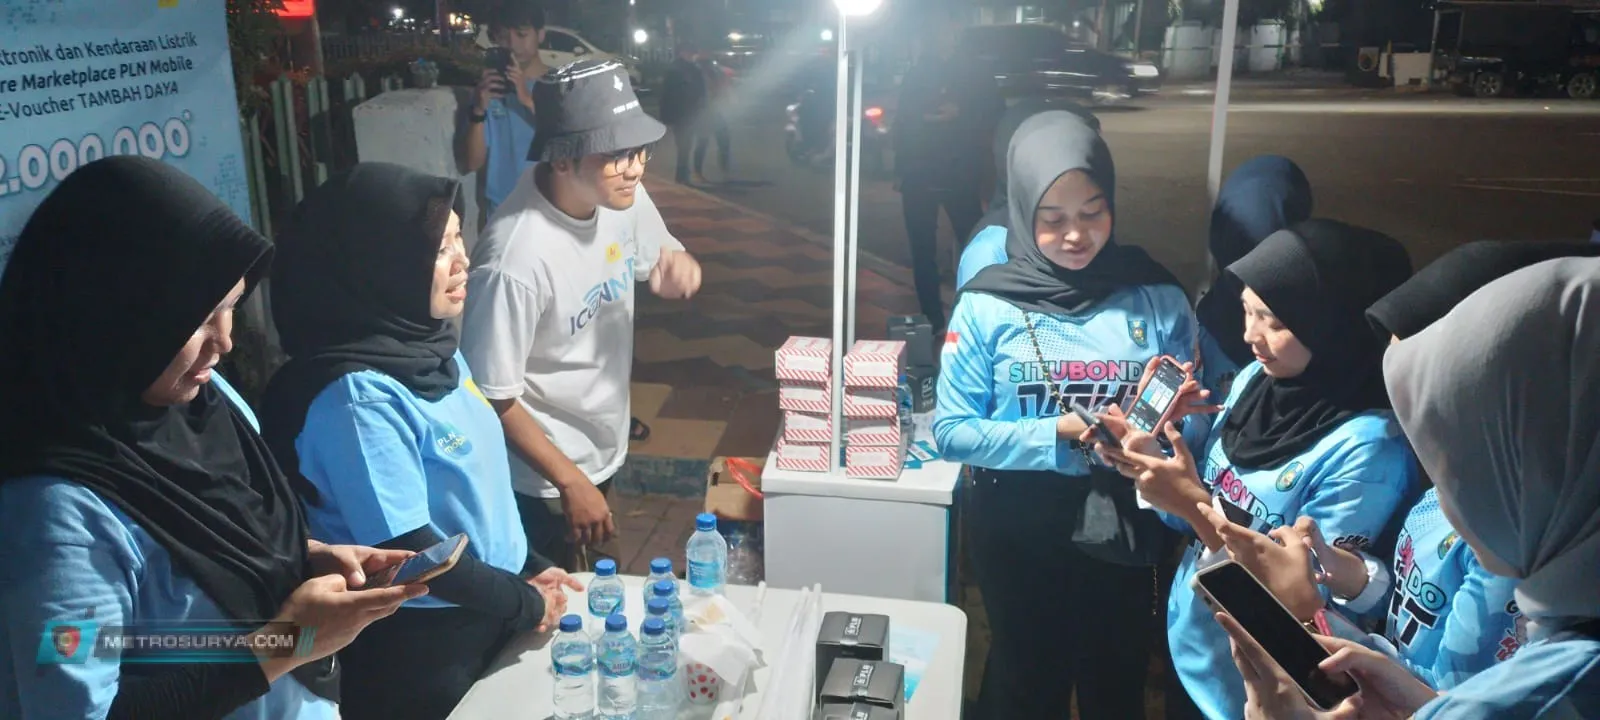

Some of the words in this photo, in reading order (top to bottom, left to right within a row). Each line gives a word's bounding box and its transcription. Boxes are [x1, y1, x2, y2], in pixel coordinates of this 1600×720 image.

[56, 44, 83, 60] dan
[84, 37, 158, 57] Kendaraan
[158, 32, 197, 50] Listrik
[21, 66, 116, 90] Marketplace
[119, 61, 147, 78] PLN
[150, 56, 193, 74] Mobile
[78, 86, 142, 109] TAMBAH
[145, 80, 179, 99] DAYA
[1008, 360, 1144, 382] SITUBOND
